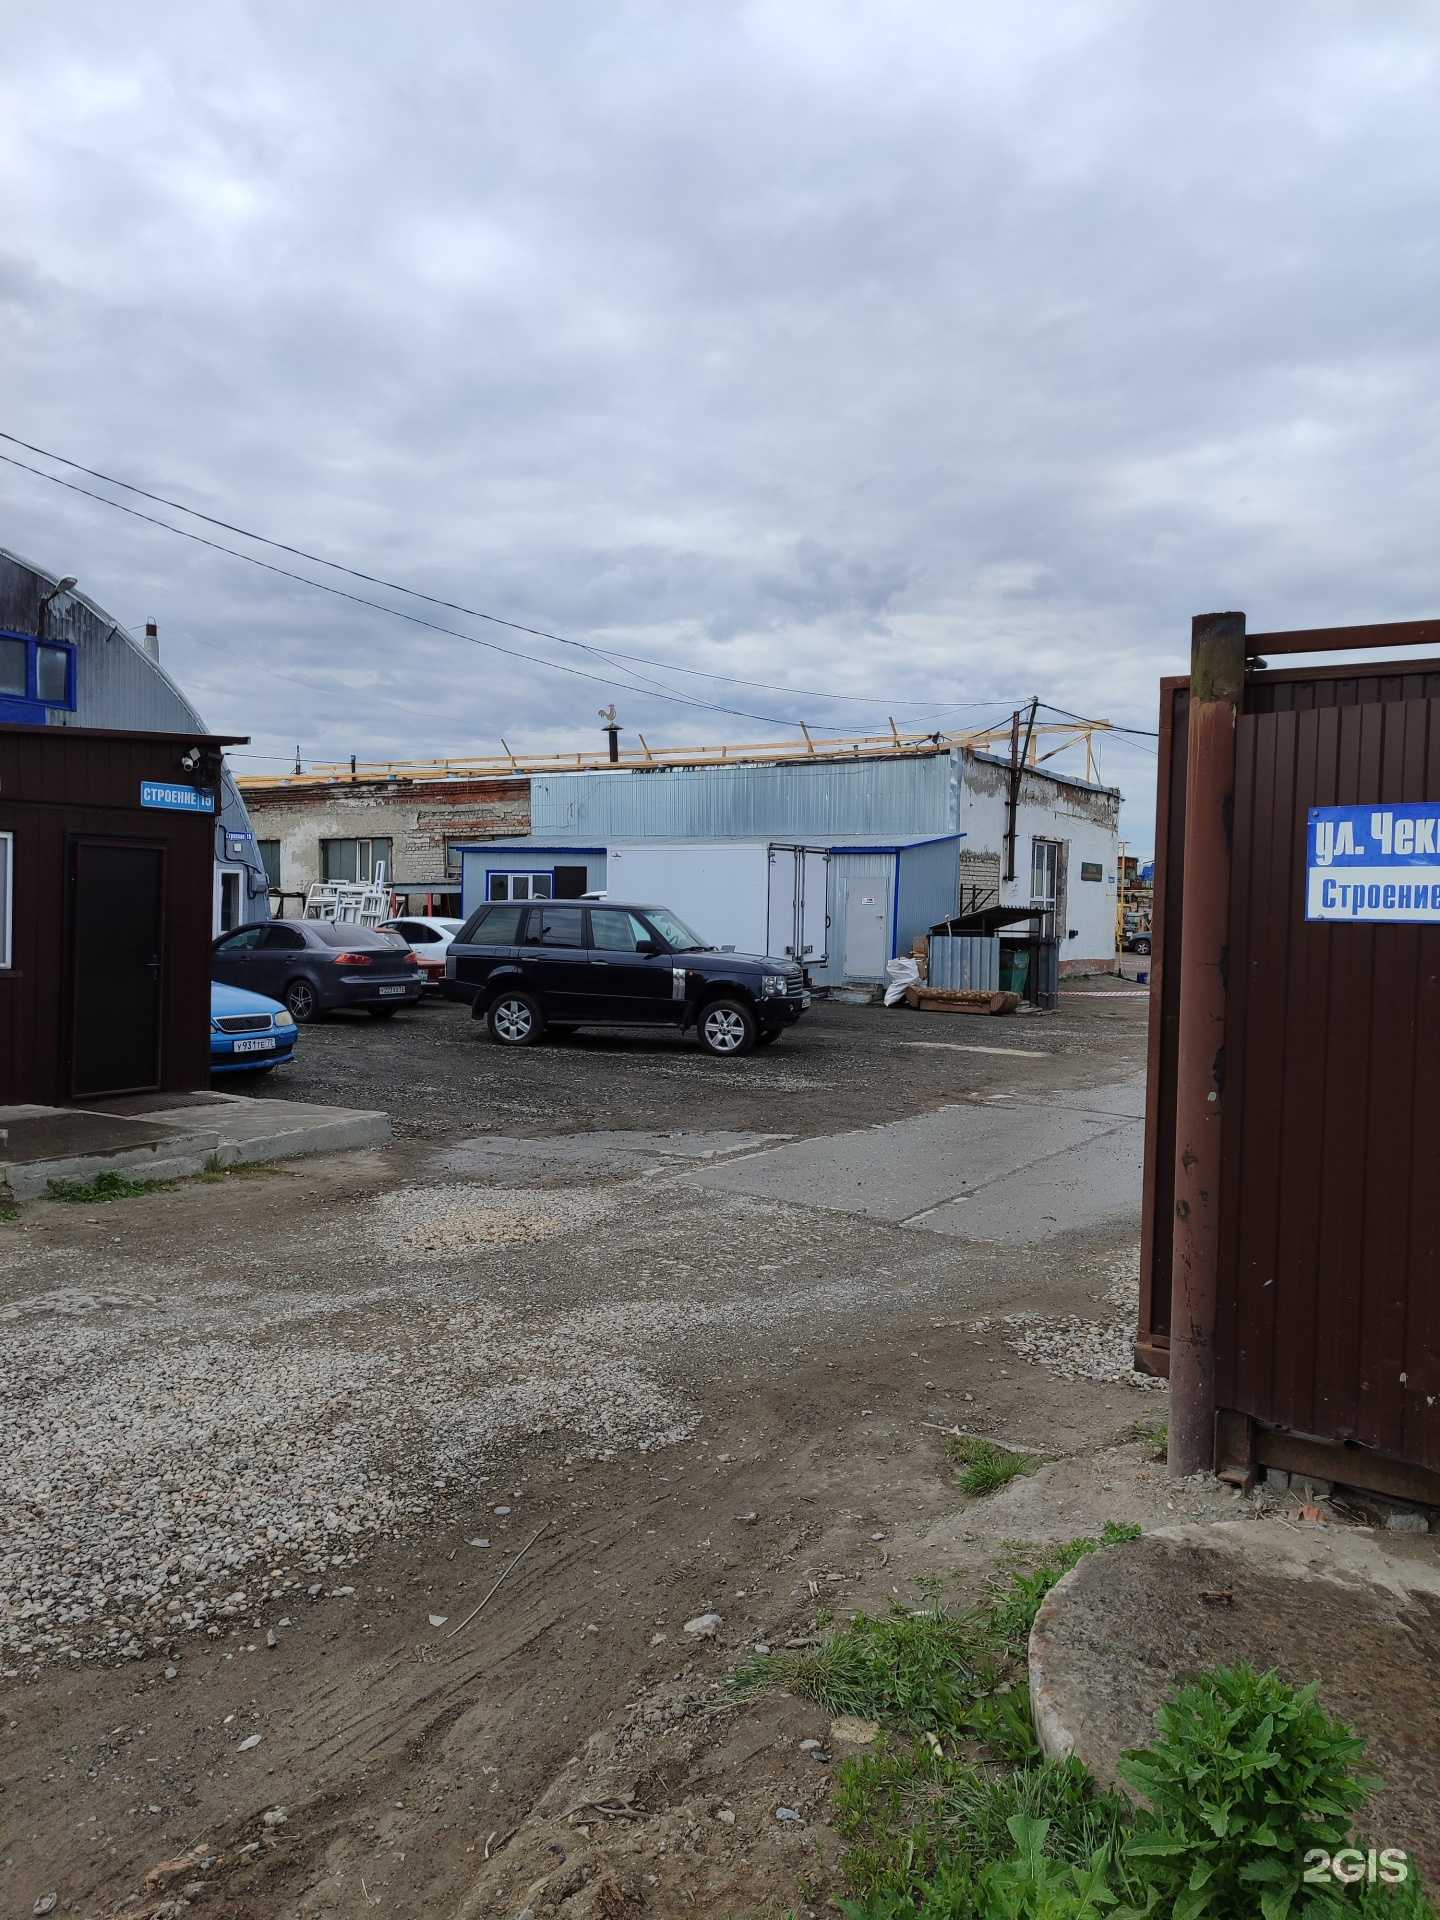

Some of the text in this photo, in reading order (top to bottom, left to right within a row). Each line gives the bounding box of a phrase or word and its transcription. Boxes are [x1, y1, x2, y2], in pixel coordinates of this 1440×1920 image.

[143, 787, 197, 805] СТРОЕНИЕ
[1315, 811, 1440, 866] ул. Чек
